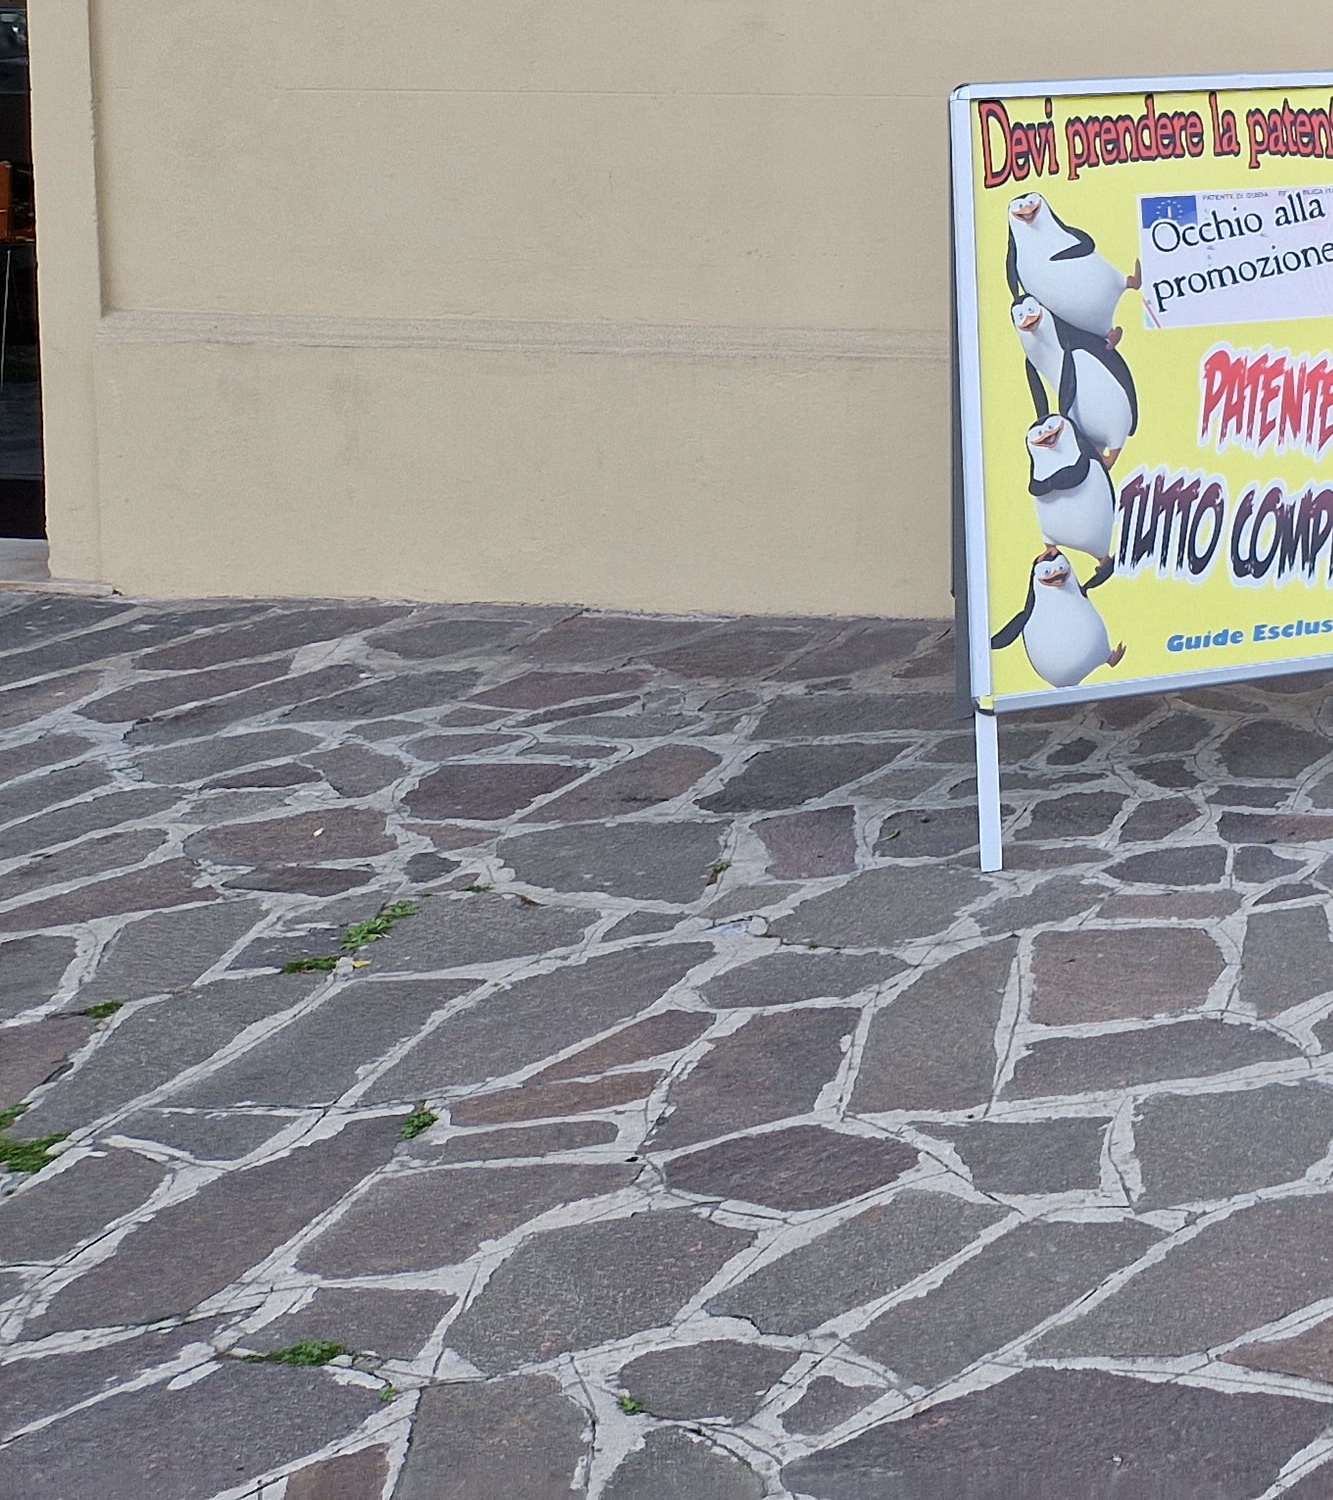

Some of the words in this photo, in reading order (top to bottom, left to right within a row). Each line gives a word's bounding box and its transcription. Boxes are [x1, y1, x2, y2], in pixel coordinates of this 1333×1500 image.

[978, 97, 1060, 189] Devi
[1065, 93, 1204, 181] prendere
[1209, 90, 1240, 157] la
[1151, 206, 1263, 252] Occhio
[1274, 191, 1327, 227] alla
[1117, 471, 1225, 576] TUTTO
[1167, 629, 1244, 653] Guide
